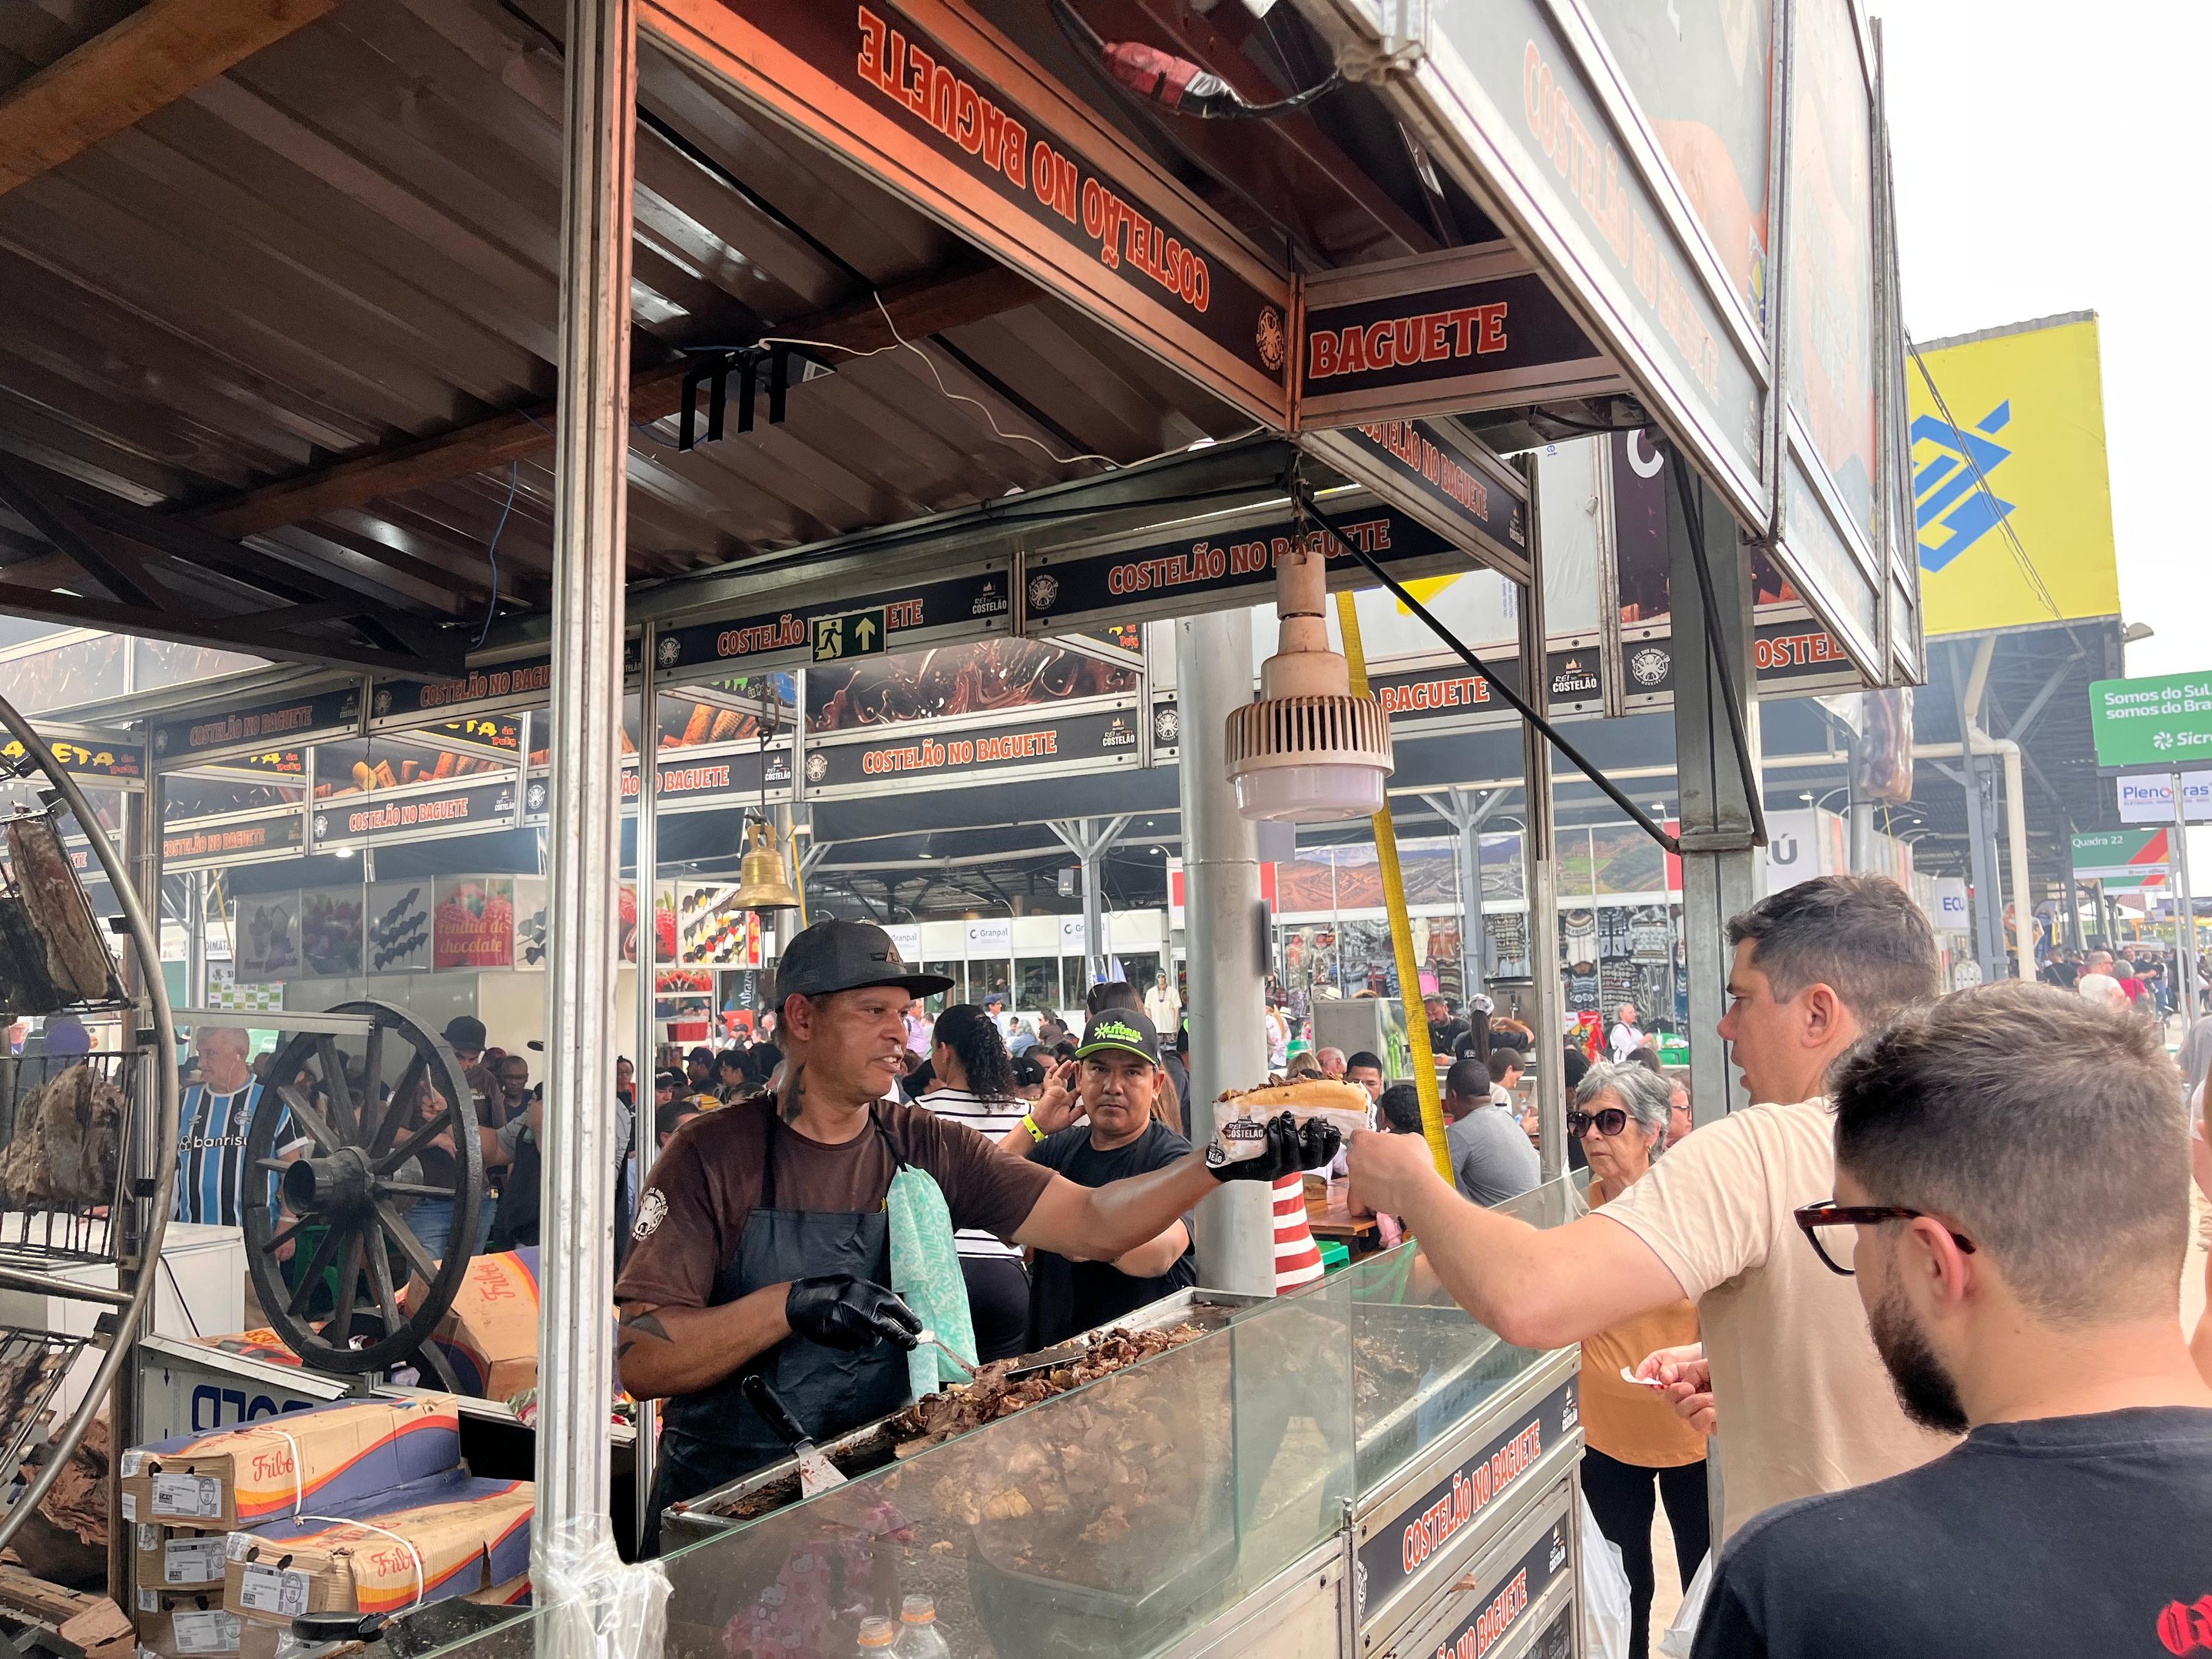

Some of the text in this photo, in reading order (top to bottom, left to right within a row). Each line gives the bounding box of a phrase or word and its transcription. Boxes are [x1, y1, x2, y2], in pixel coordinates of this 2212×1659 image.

[858, 5, 1210, 313] COSTELÃO NO BAGUETE
[1310, 302, 1508, 379] BAGUETE
[1422, 438, 1440, 485] NO
[1441, 452, 1488, 522] BAGUETE
[1108, 518, 1391, 595] COSTELÃO NO BGUETE
[972, 599, 1007, 614] COSTELÃO
[717, 614, 804, 657] COSTELÃO
[488, 671, 511, 696] NO
[1380, 676, 1490, 714] BAGUETE
[1552, 677, 1598, 693] COSTELÃO
[2104, 691, 2159, 706] Somos
[2161, 687, 2182, 700] do
[2106, 705, 2159, 720] somos
[2161, 701, 2181, 714] do
[243, 716, 260, 737] NO
[863, 730, 1058, 775] COSTELÃO NO BAGUETE
[1103, 733, 1135, 747] COSTELÃO
[665, 765, 730, 793] BAGUETE
[349, 797, 469, 832] COSTELÃO NO BAGUETE
[2072, 836, 2124, 848] Quadra 22
[490, 919, 505, 933] de
[980, 927, 1008, 939] Granpal
[440, 938, 502, 953] chocolate
[1403, 1419, 1541, 1575] COSTELÃO NO BAGUETE
[1477, 1567, 1528, 1654] BAGUETE
